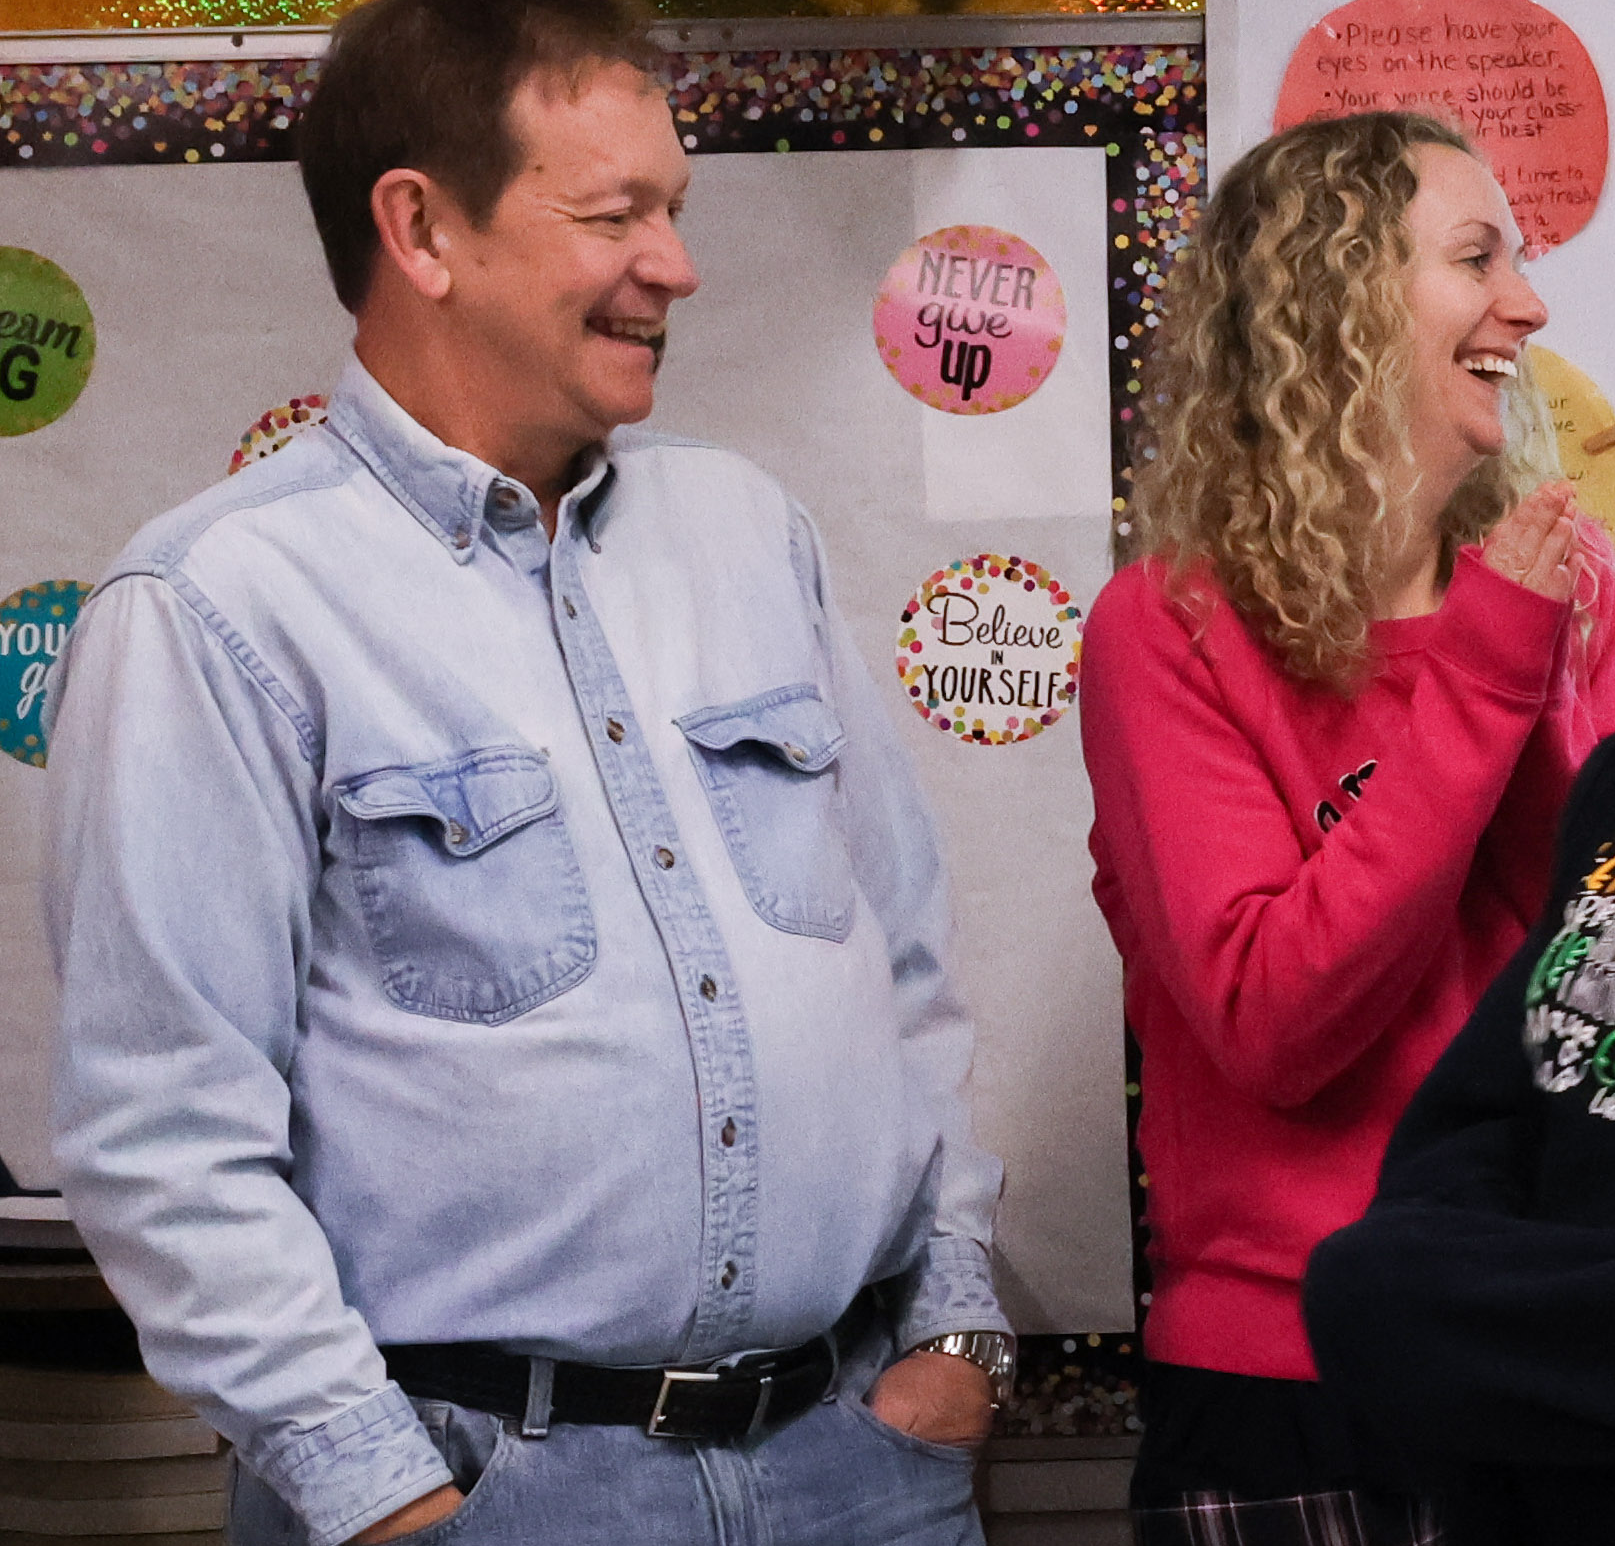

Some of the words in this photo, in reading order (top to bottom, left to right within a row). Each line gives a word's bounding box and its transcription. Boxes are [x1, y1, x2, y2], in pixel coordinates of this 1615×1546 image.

[1346, 22, 1434, 48] Please
[1444, 14, 1508, 41] have
[1512, 20, 1561, 46] your
[1316, 54, 1368, 80] eyes
[1382, 55, 1408, 73] on
[1416, 50, 1460, 72] the
[1466, 47, 1566, 78] speaker.
[1334, 89, 1380, 109] Your
[1465, 78, 1536, 104] should
[1544, 76, 1568, 98] be
[1471, 106, 1515, 125] your
[1499, 121, 1547, 139] best
[1516, 166, 1561, 184] time
[1567, 164, 1585, 182] to
[915, 250, 1037, 311] NEVER
[914, 300, 1013, 349] give
[939, 341, 994, 402] up
[926, 590, 1064, 650] Believe
[990, 650, 1004, 666] IN
[922, 664, 1062, 709] YOURSELF
